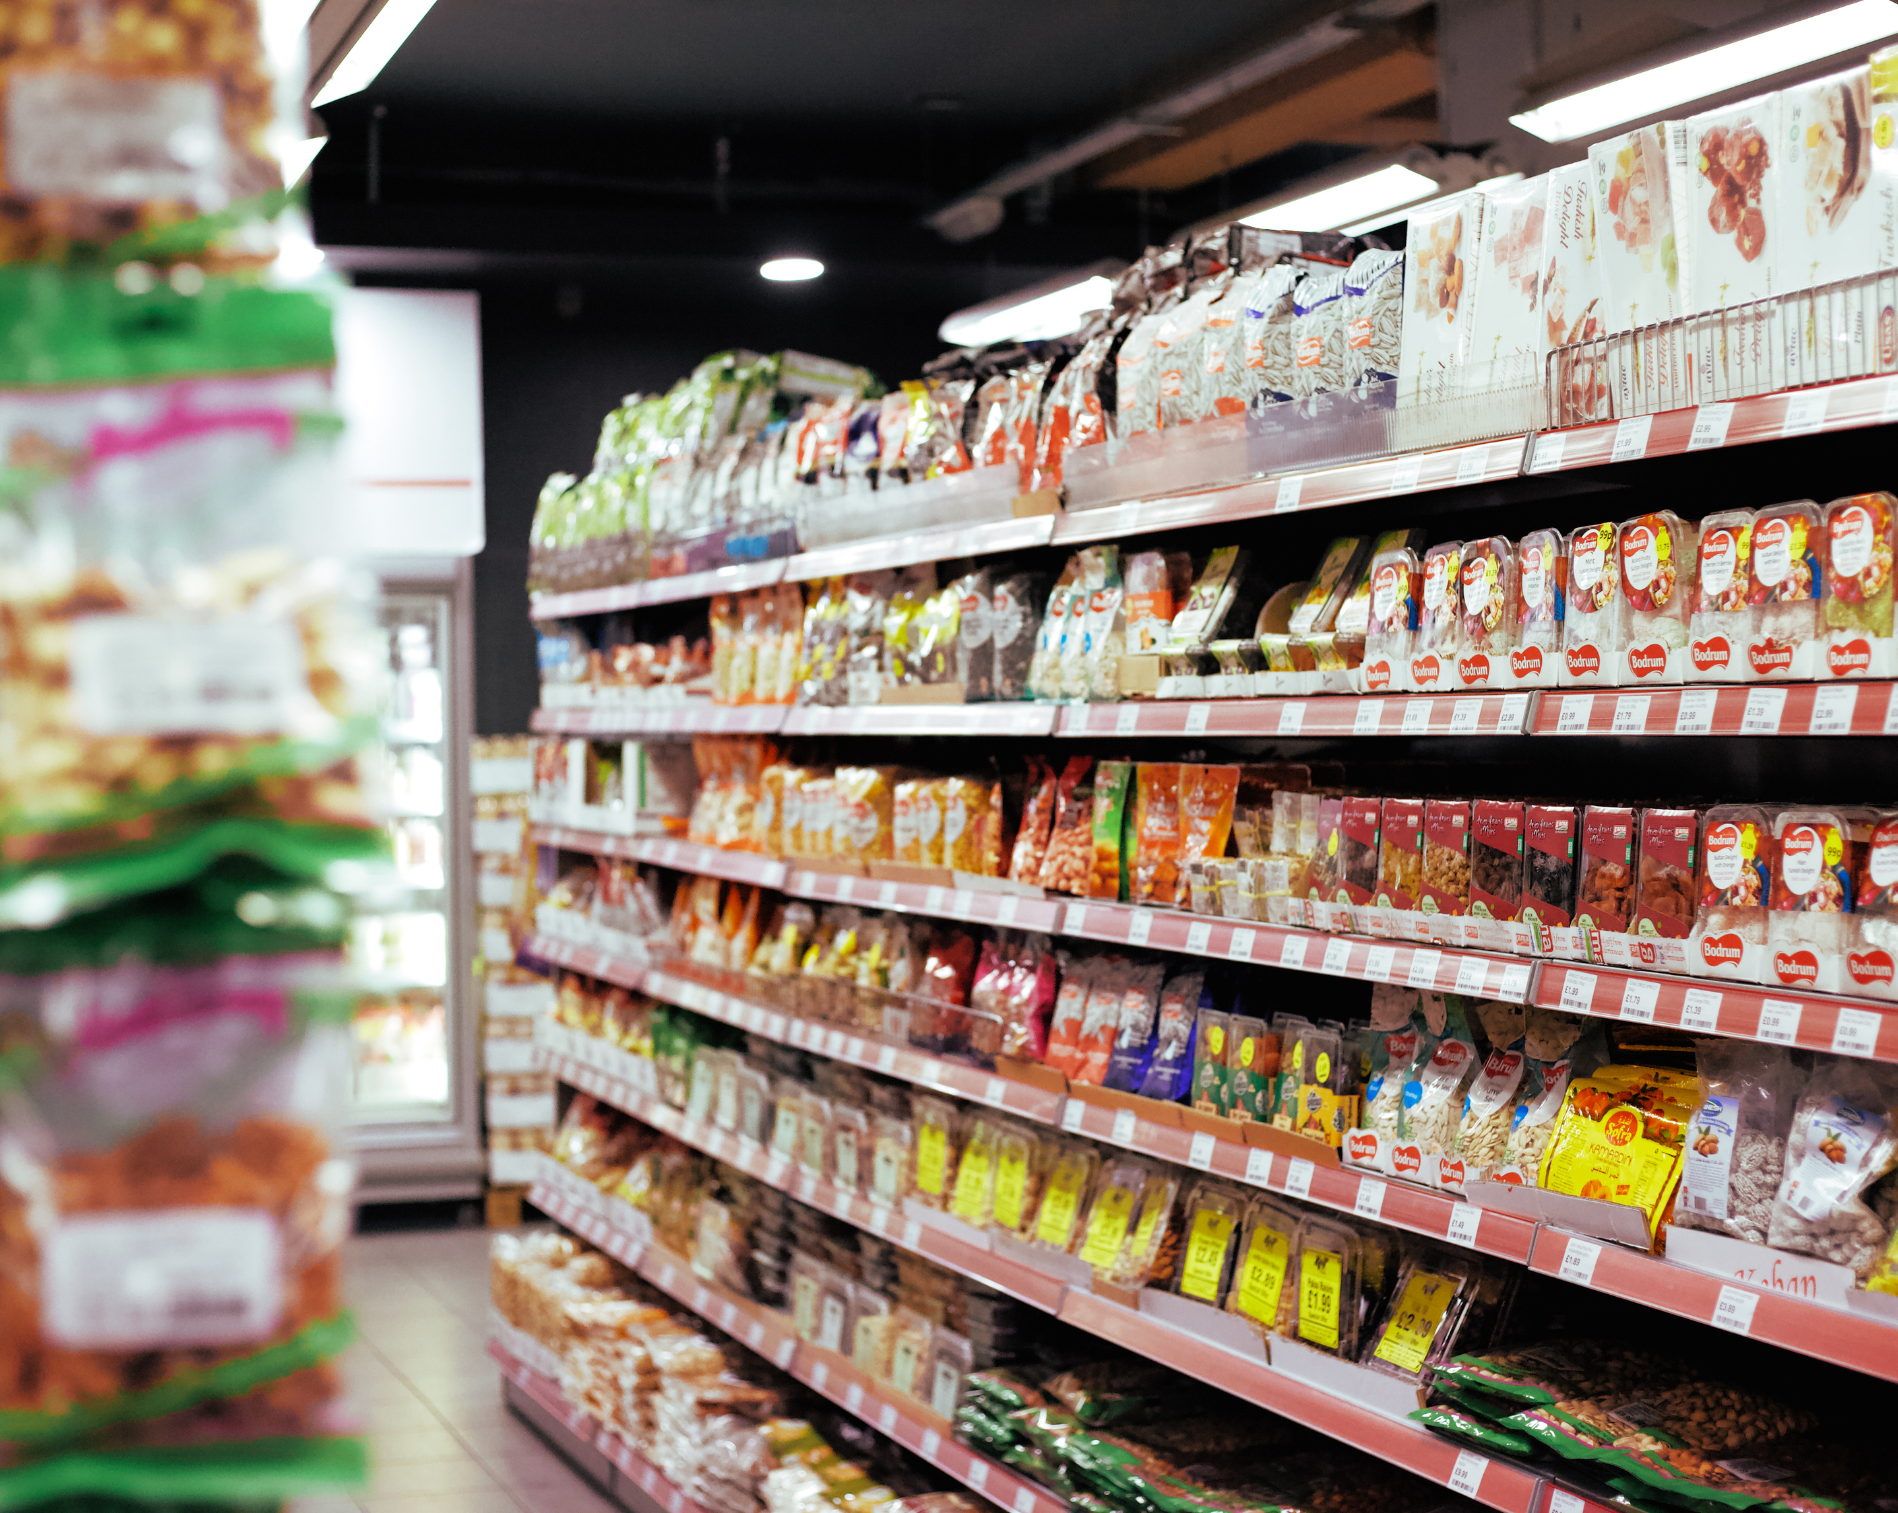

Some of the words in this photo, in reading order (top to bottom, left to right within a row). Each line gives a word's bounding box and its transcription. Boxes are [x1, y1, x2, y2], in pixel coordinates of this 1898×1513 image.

[1559, 184, 1574, 249] Delight
[1573, 179, 1588, 241] Turkish
[1833, 519, 1862, 533] Bodrum
[1599, 530, 1612, 543] 99p
[1756, 529, 1783, 544] Bodrum
[1575, 540, 1597, 552] Bodrum
[1624, 539, 1647, 551] Bodrum
[1703, 539, 1728, 554] Bodrum
[1568, 654, 1598, 668] Bodrum
[1632, 654, 1665, 669] Bodrum
[1694, 647, 1728, 662] Bodrum
[1751, 648, 1790, 665] Bodrum
[1830, 649, 1869, 666] Bodrum
[1512, 655, 1541, 670] Bodrum
[1367, 671, 1390, 682] Bodrum
[1413, 664, 1438, 678] Bodrum
[1460, 663, 1488, 677] Bodrum
[1561, 712, 1575, 720] £0.99
[1616, 712, 1632, 720] £1.79
[1708, 834, 1735, 846] Bodrum
[1784, 837, 1812, 849] Bodrum
[1827, 846, 1842, 859] 99p
[1704, 942, 1741, 958] Bodrum
[1777, 959, 1816, 976] Bodrum
[1851, 959, 1892, 977] Bodrum
[1564, 985, 1579, 996] £1.99
[1625, 994, 1641, 1005] £1.79
[1685, 1005, 1702, 1016] £1.39
[1762, 1016, 1780, 1027] £0.99
[1606, 1122, 1632, 1142] Sofra
[1350, 1143, 1376, 1155] Bodrum
[1394, 1153, 1420, 1168] Bodrum
[1451, 1219, 1465, 1229] £1.49
[1564, 1255, 1581, 1267] £1.89
[1308, 1289, 1332, 1314] £1.99
[1718, 1301, 1736, 1314] £3.89
[1454, 1466, 1468, 1479] £9.99
